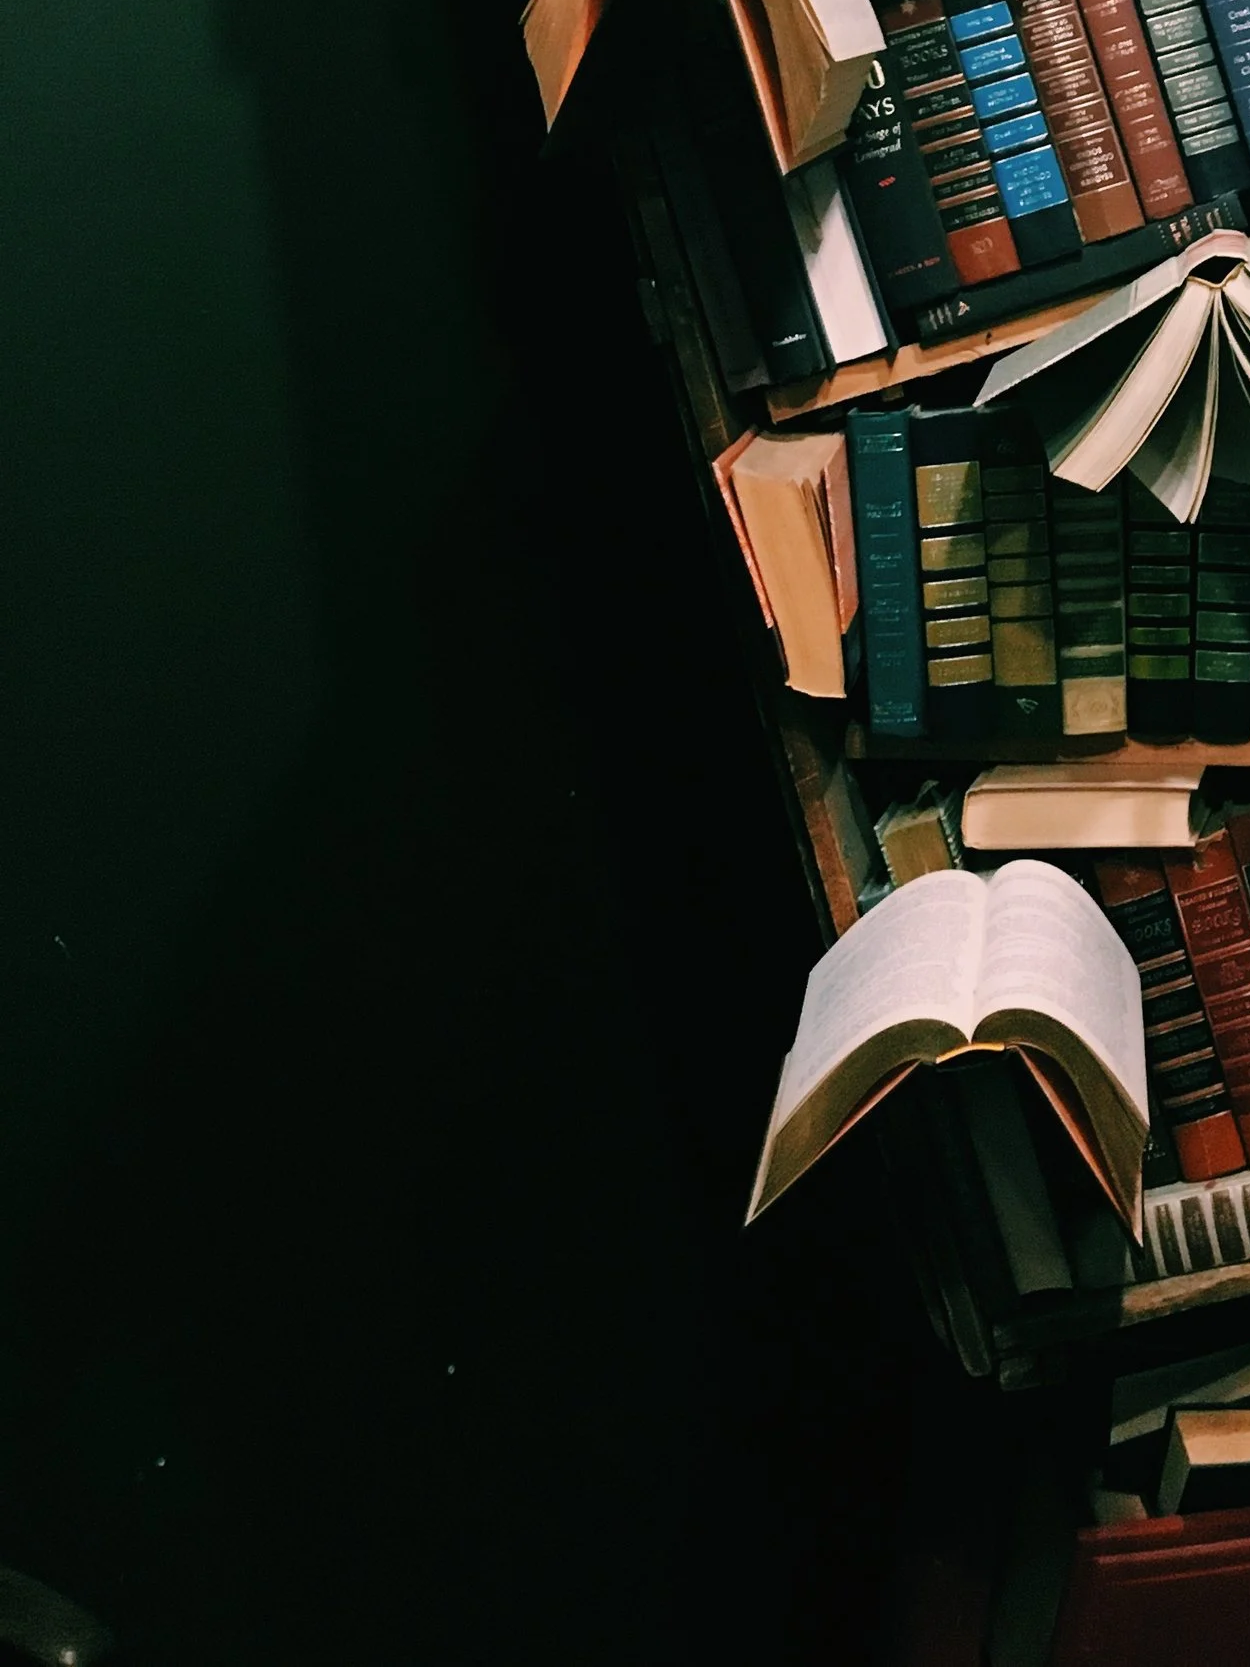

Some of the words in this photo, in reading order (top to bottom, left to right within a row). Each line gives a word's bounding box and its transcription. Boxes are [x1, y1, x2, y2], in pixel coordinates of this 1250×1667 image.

[901, 44, 948, 69] BOOKS
[864, 125, 891, 143] Siege
[890, 120, 904, 139] of
[852, 137, 903, 163] Leningrad
